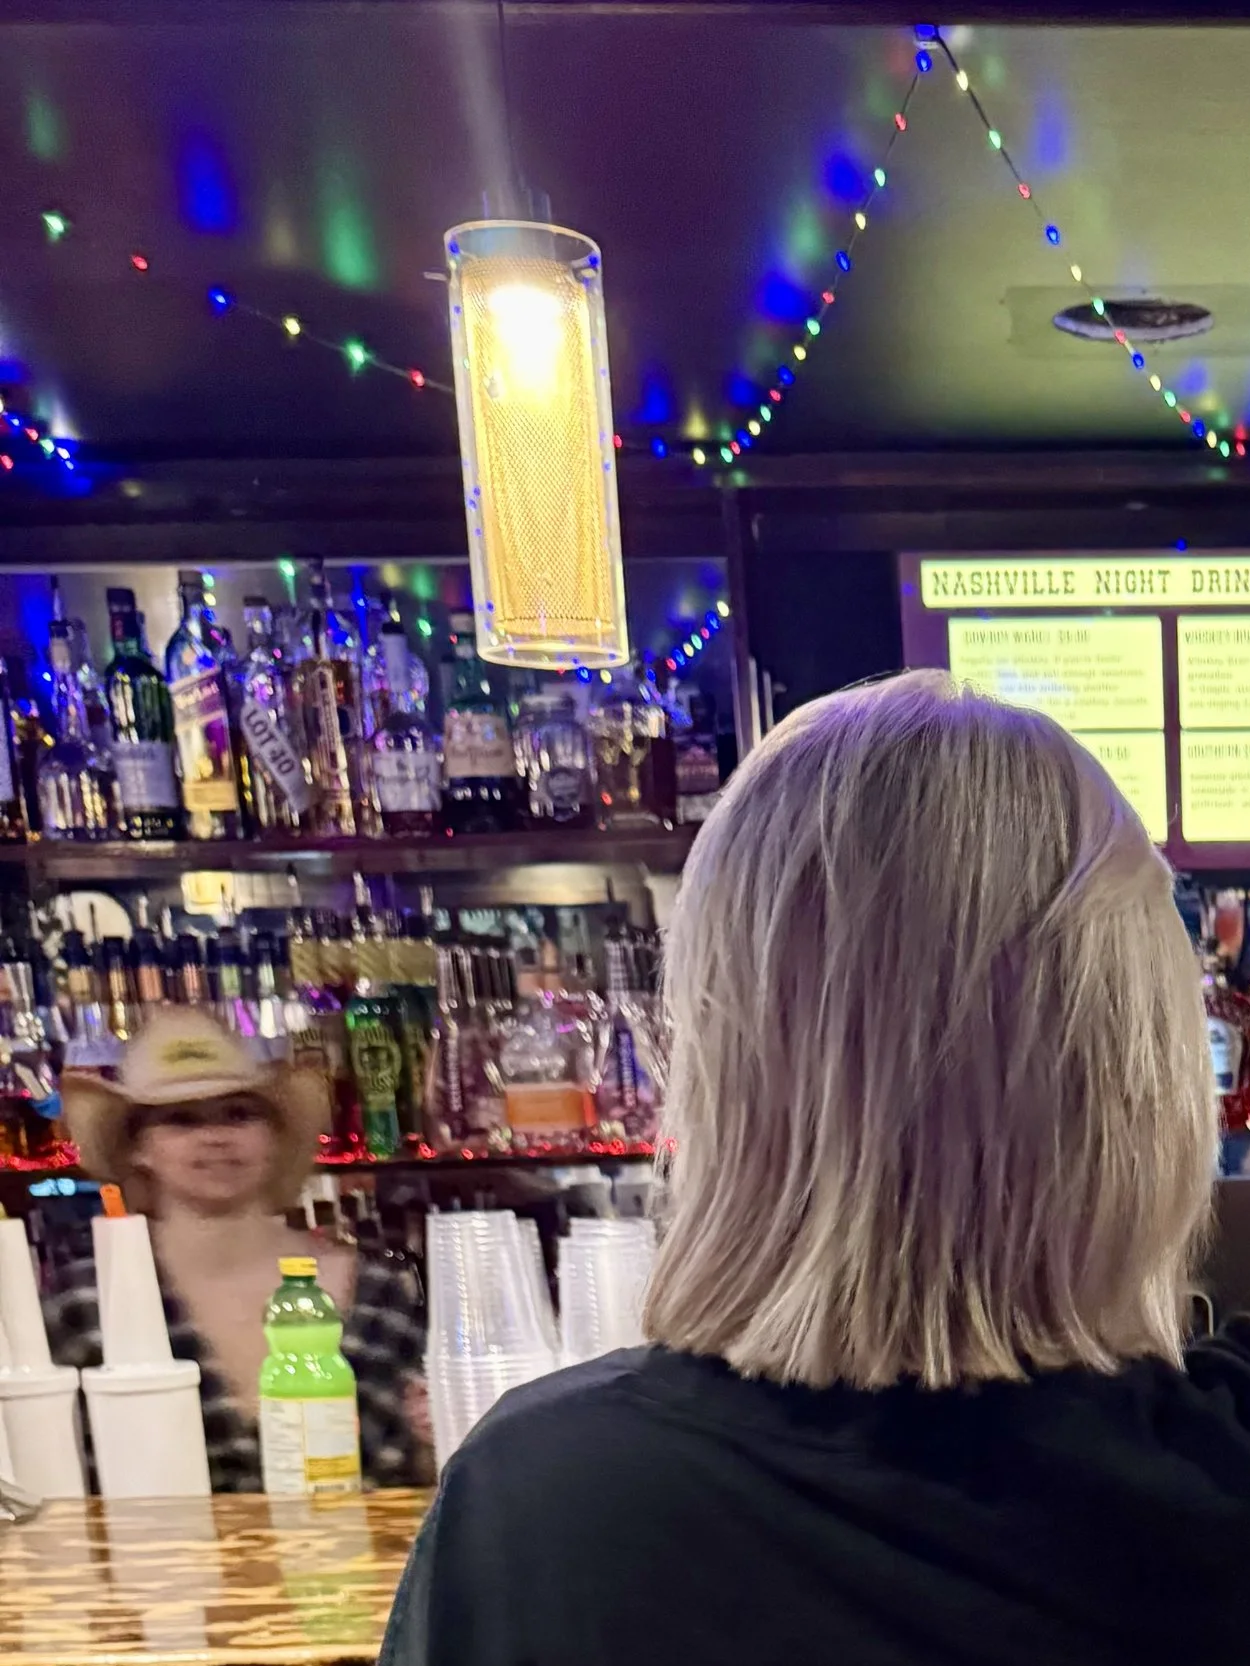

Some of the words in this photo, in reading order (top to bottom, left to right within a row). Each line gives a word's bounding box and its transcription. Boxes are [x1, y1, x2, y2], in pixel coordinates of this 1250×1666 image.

[932, 569, 1076, 597] NASHVILLE
[1095, 568, 1172, 596] NIGHT
[244, 707, 274, 747] LOT
